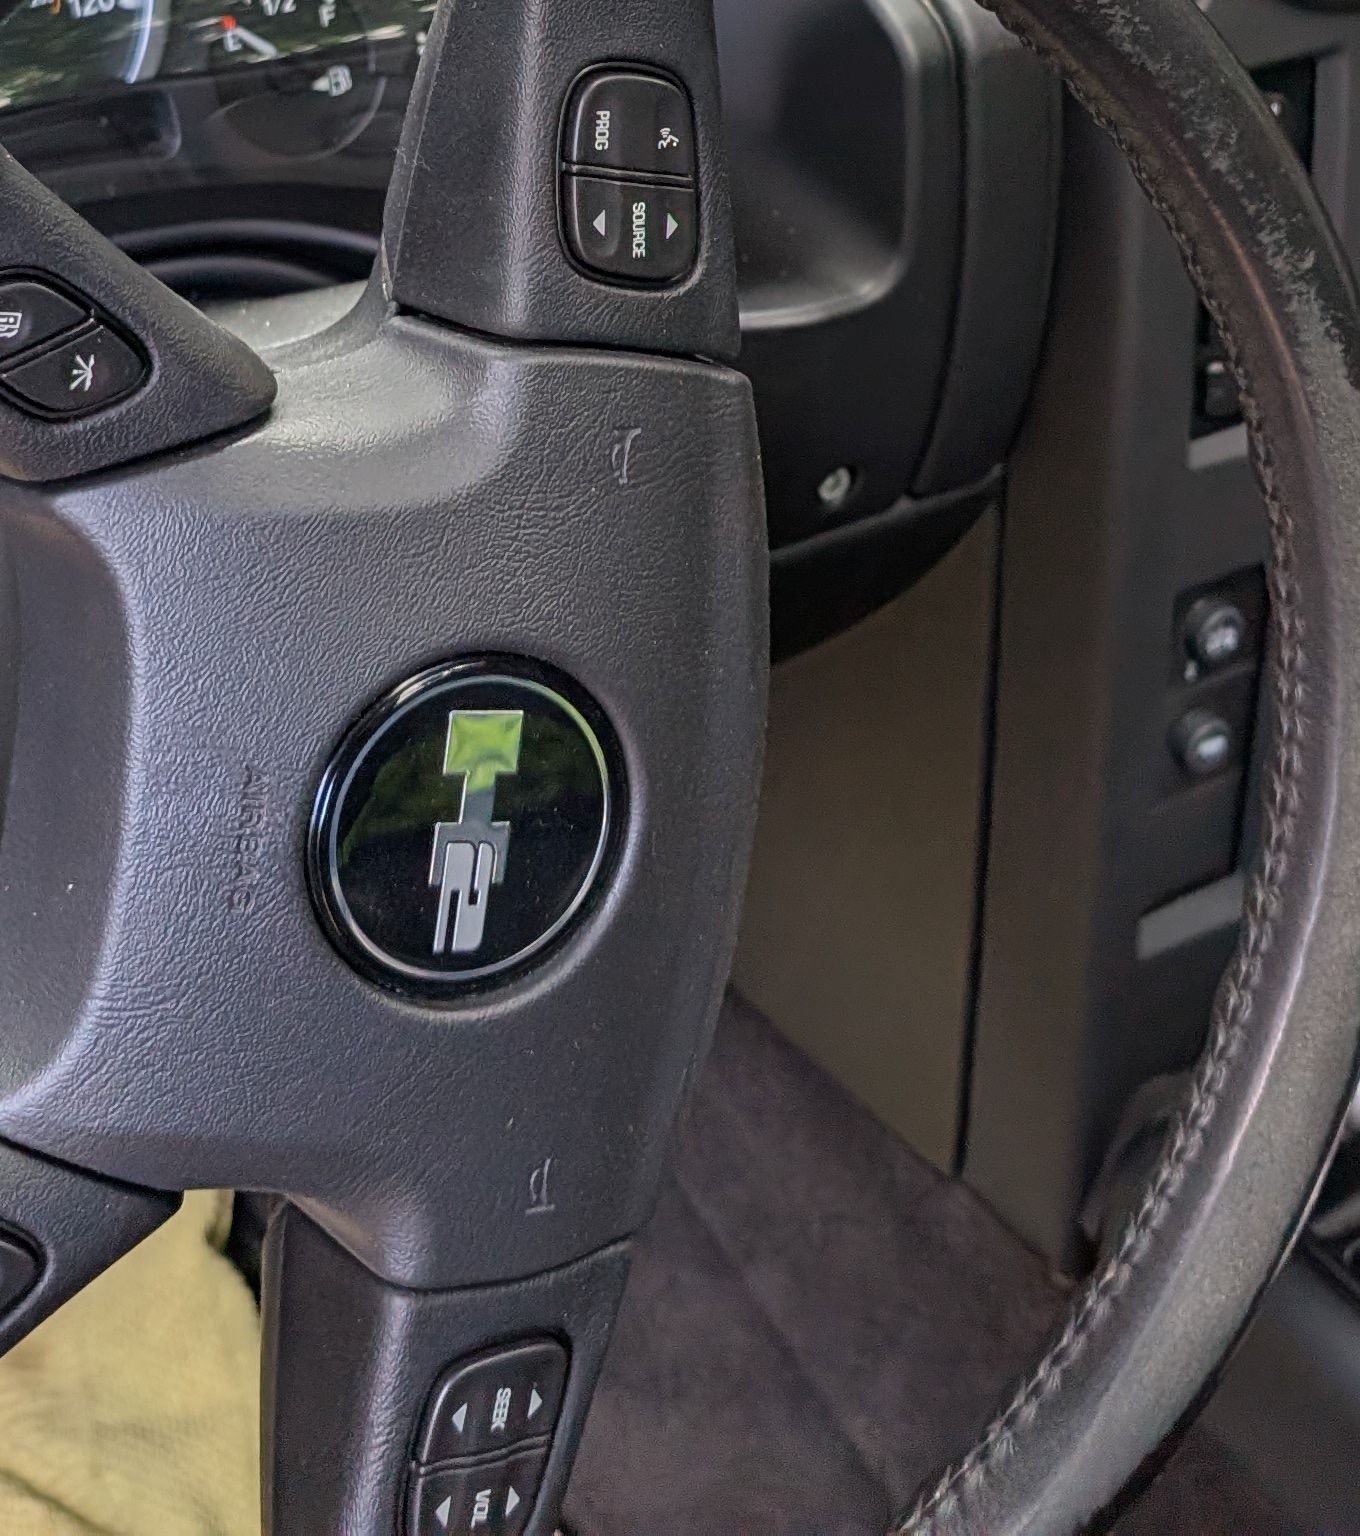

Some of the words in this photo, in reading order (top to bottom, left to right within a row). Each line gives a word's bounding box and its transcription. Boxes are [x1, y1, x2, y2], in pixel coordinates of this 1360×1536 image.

[318, 4, 337, 28] F
[594, 110, 611, 151] PROG
[632, 201, 646, 259] SOURCE
[230, 765, 269, 915] AIRBAG
[491, 1386, 512, 1432] SEEK
[470, 1488, 492, 1528] VOL
